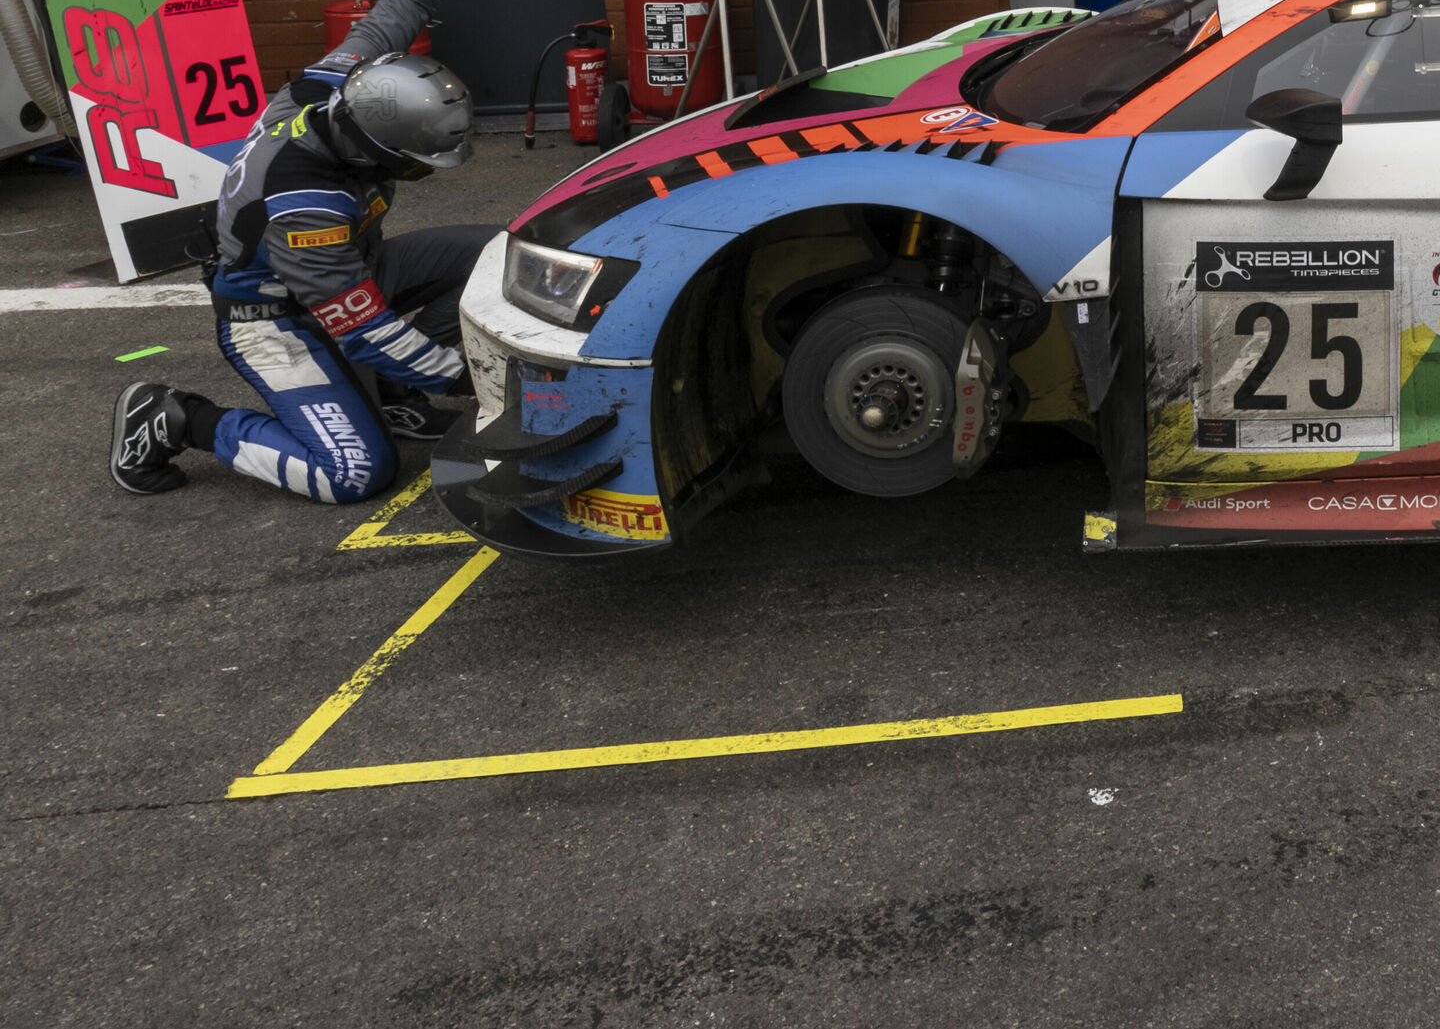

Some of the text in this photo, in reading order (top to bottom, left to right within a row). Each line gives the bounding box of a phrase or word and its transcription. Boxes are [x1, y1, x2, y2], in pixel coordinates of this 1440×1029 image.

[185, 55, 259, 126] 25
[289, 228, 350, 247] PIRELLI
[1236, 249, 1380, 267] REBELLION
[355, 303, 380, 324] GROUP
[1233, 301, 1363, 411] 25
[1291, 422, 1342, 443] PRO
[311, 400, 372, 496] SAINTéLOC
[569, 494, 663, 531] PIRELLI
[1185, 497, 1271, 513] Audi Sport
[1308, 496, 1375, 510] CASA
